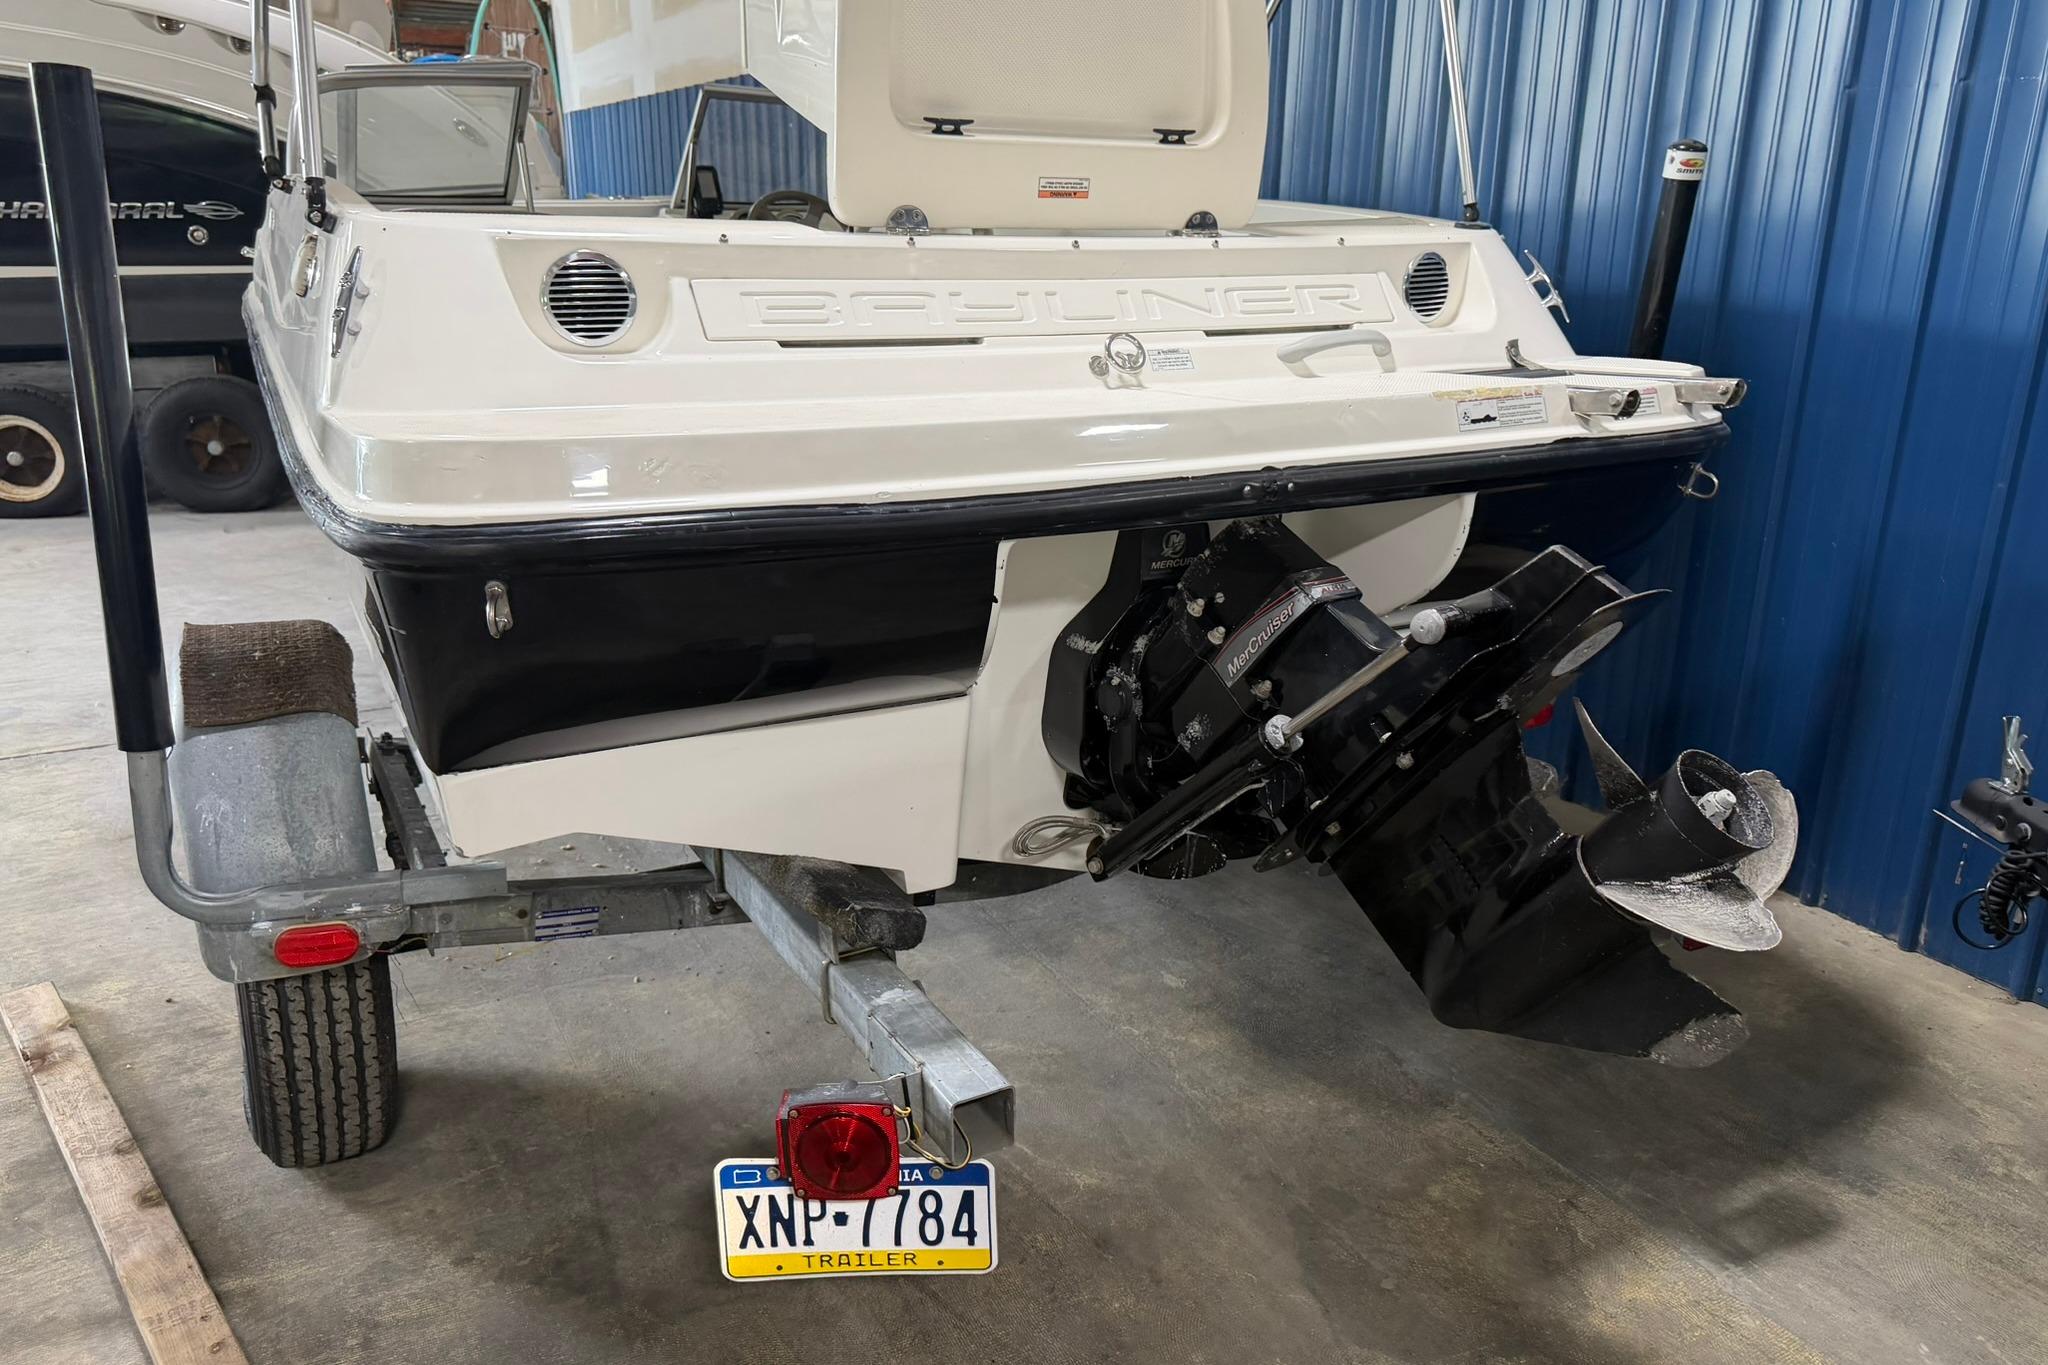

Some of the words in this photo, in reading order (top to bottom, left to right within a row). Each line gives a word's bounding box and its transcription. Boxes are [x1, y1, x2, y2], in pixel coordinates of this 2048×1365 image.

[740, 284, 1364, 328] BAYLINER
[1226, 602, 1296, 678] MerCruiser
[802, 1252, 918, 1269] TRAILER
